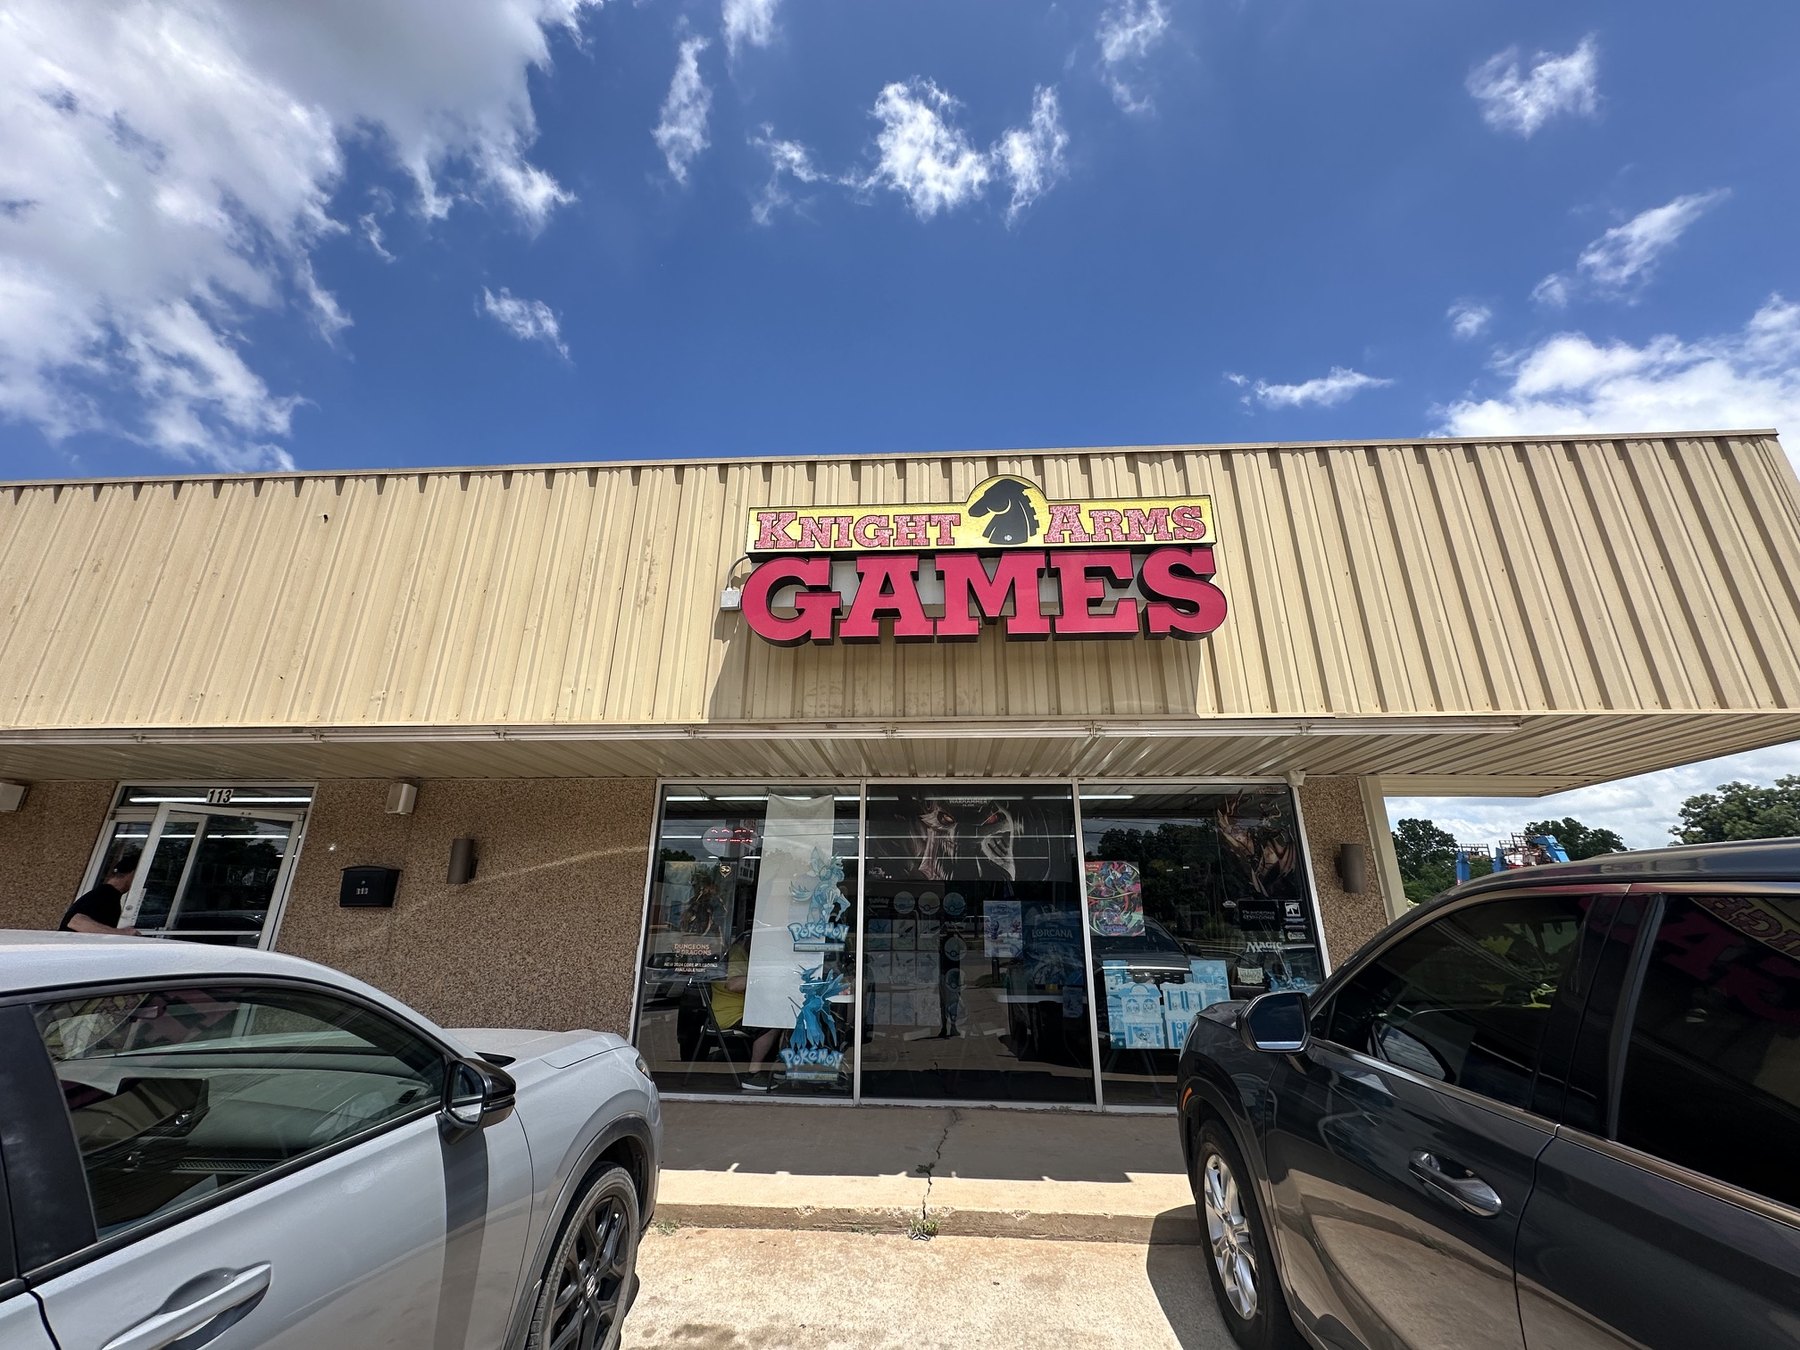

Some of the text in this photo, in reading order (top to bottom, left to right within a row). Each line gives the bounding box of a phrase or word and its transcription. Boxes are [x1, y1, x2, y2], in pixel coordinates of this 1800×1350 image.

[755, 504, 1207, 549] KNIGHT ARMS
[741, 545, 1228, 647] GAMES
[208, 789, 232, 803] 113
[1032, 929, 1074, 939] LORCANA
